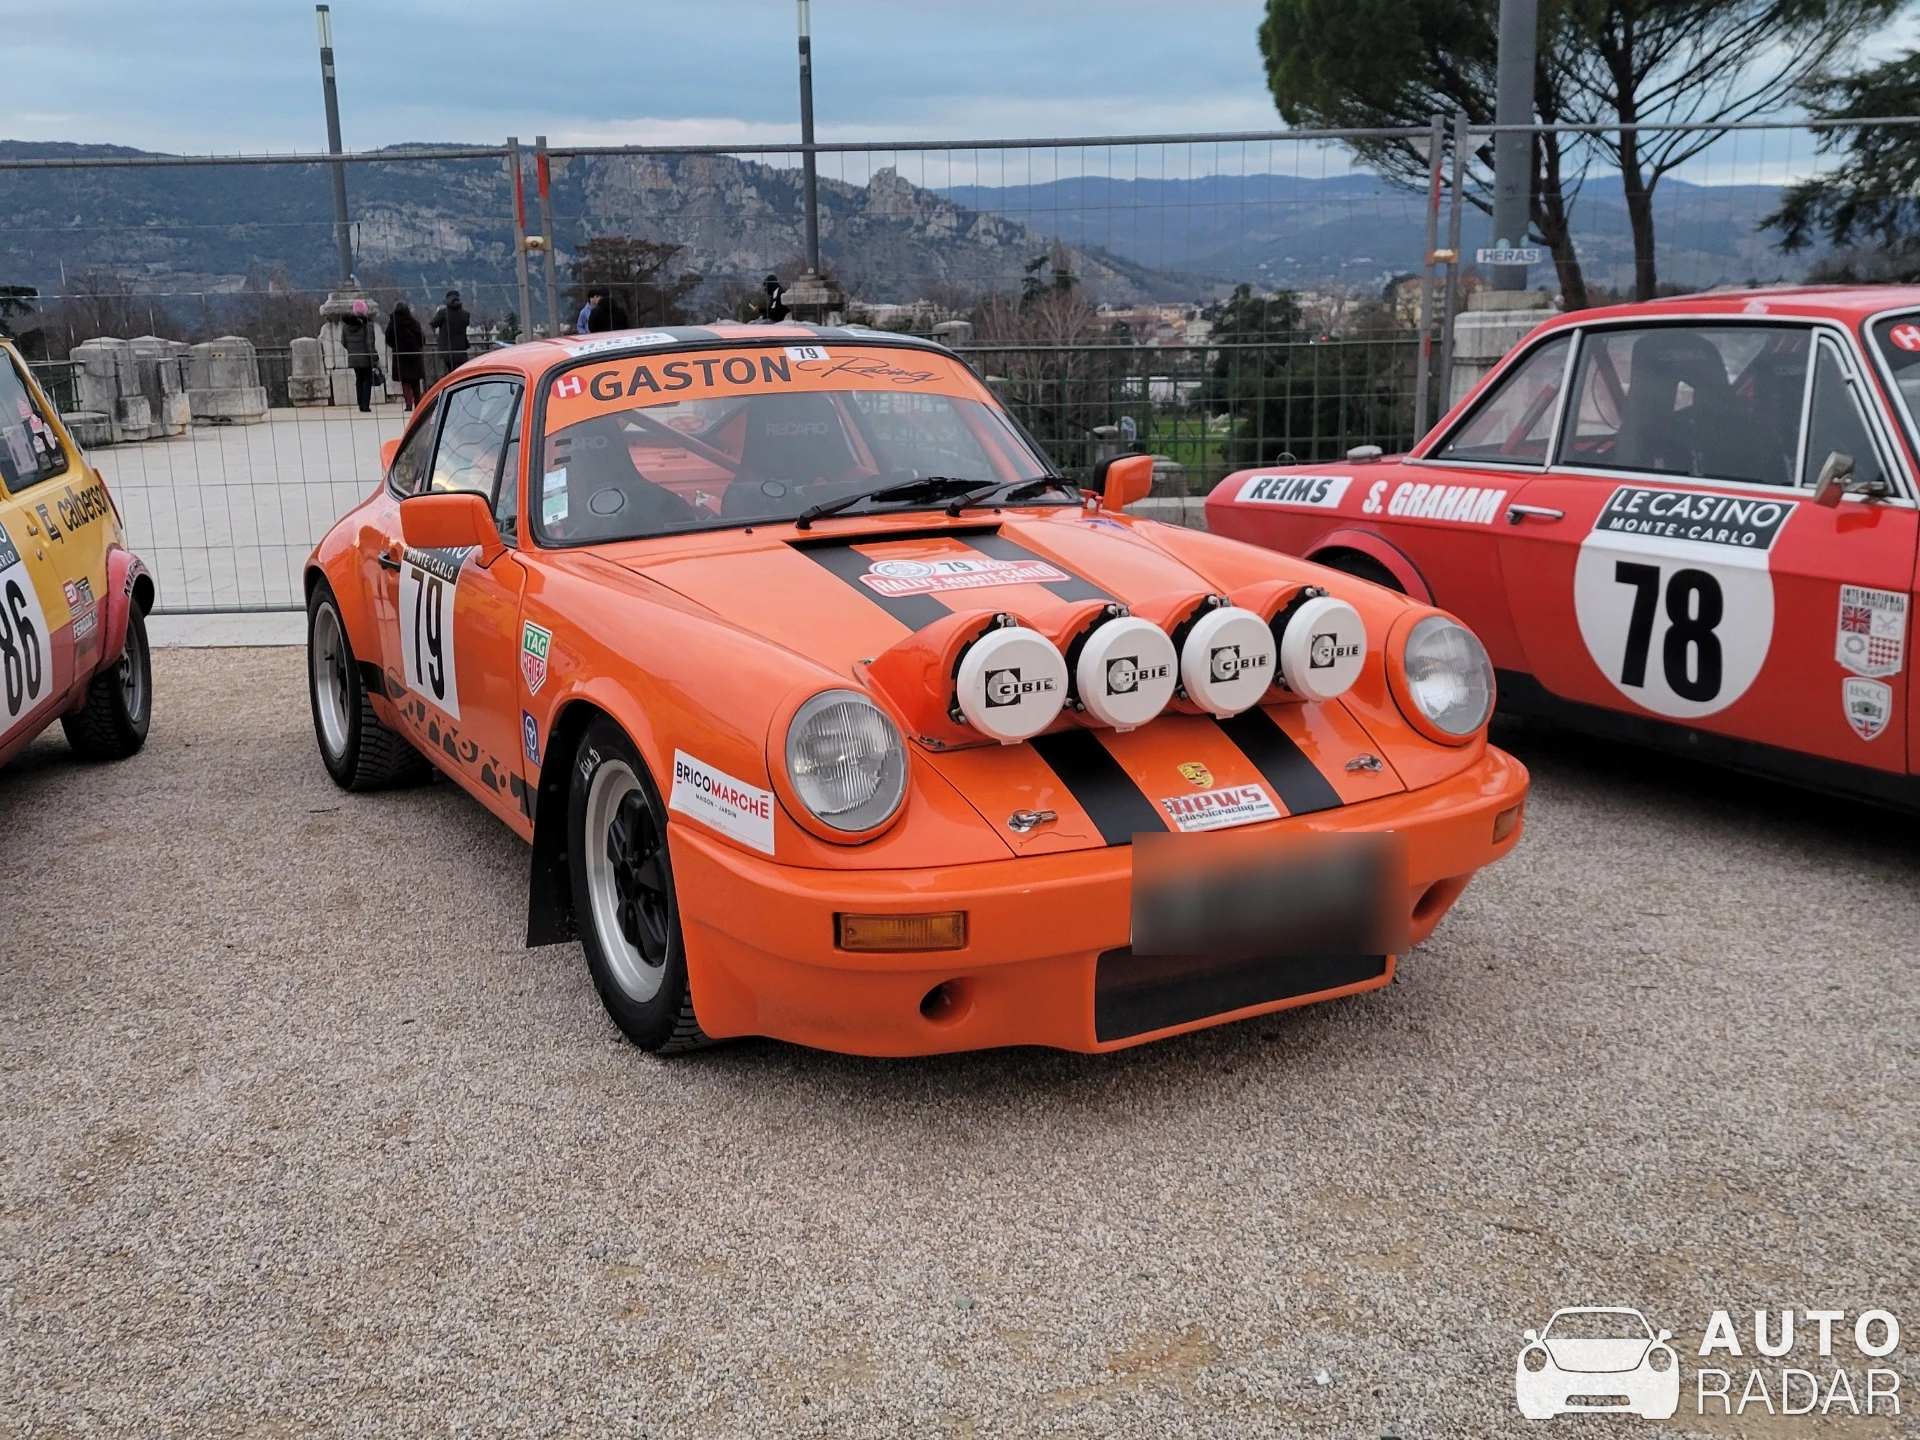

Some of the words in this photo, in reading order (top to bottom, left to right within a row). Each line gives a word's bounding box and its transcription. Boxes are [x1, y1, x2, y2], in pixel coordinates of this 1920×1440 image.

[1482, 250, 1537, 262] HERAS
[794, 347, 818, 360] 79
[589, 356, 791, 402] GASTON
[796, 355, 945, 384] Racing
[765, 421, 829, 437] RECARO
[1249, 477, 1335, 503] REIMS
[1361, 480, 1388, 514] S.
[1387, 481, 1507, 525] GRAHAM
[1610, 489, 1645, 514] LE
[1648, 490, 1782, 529] CASINO
[938, 561, 973, 573] 79
[870, 577, 942, 593] RALLYE
[410, 567, 445, 701] 79
[526, 628, 547, 657] TAG
[1615, 560, 1724, 703] 78
[0, 579, 42, 716] 86
[523, 652, 545, 686] HEUER
[1222, 655, 1267, 671] CIBIE
[999, 679, 1054, 695] CIBIE
[1849, 684, 1886, 702] HSCC
[695, 793, 714, 808] MAISON
[718, 805, 737, 819] JARDIN
[1170, 786, 1263, 816] news
